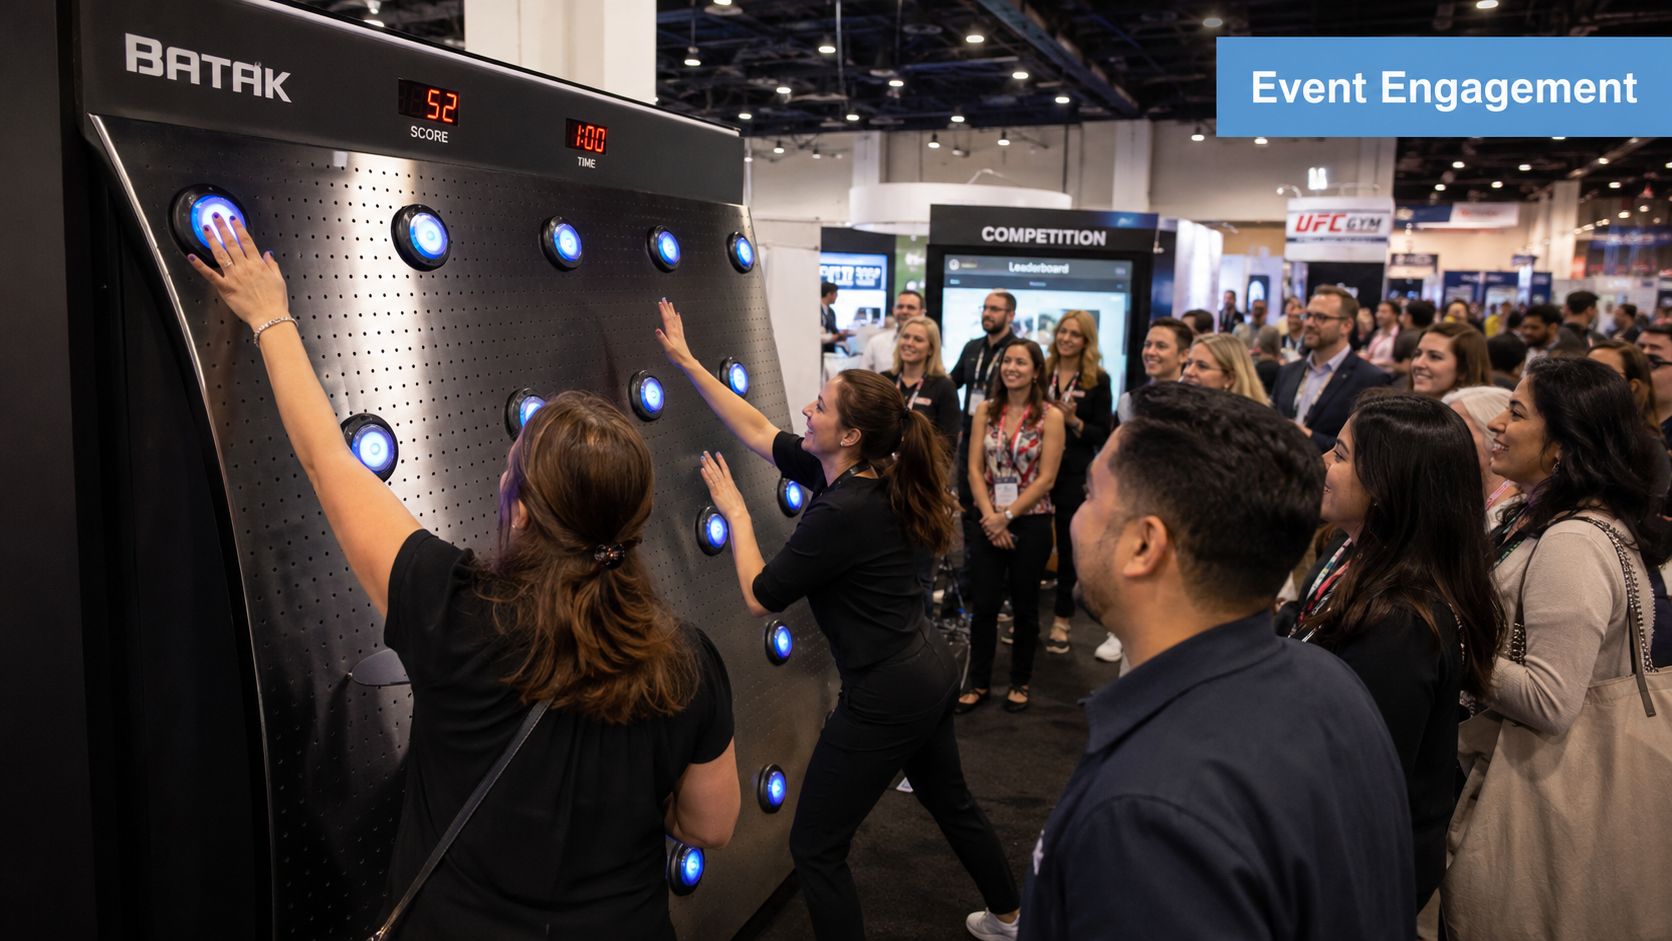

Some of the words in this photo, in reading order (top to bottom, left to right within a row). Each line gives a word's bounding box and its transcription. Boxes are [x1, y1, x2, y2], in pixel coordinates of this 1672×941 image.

[125, 33, 292, 103] BATAK
[427, 89, 457, 123] 52
[410, 125, 449, 144] SCORE
[575, 124, 606, 153] 1:00
[577, 156, 596, 169] TIME
[1295, 213, 1346, 232] UFC
[1346, 217, 1382, 230] GYM
[981, 226, 1107, 247] COMPETITION
[1008, 261, 1070, 275] Leaderboard
